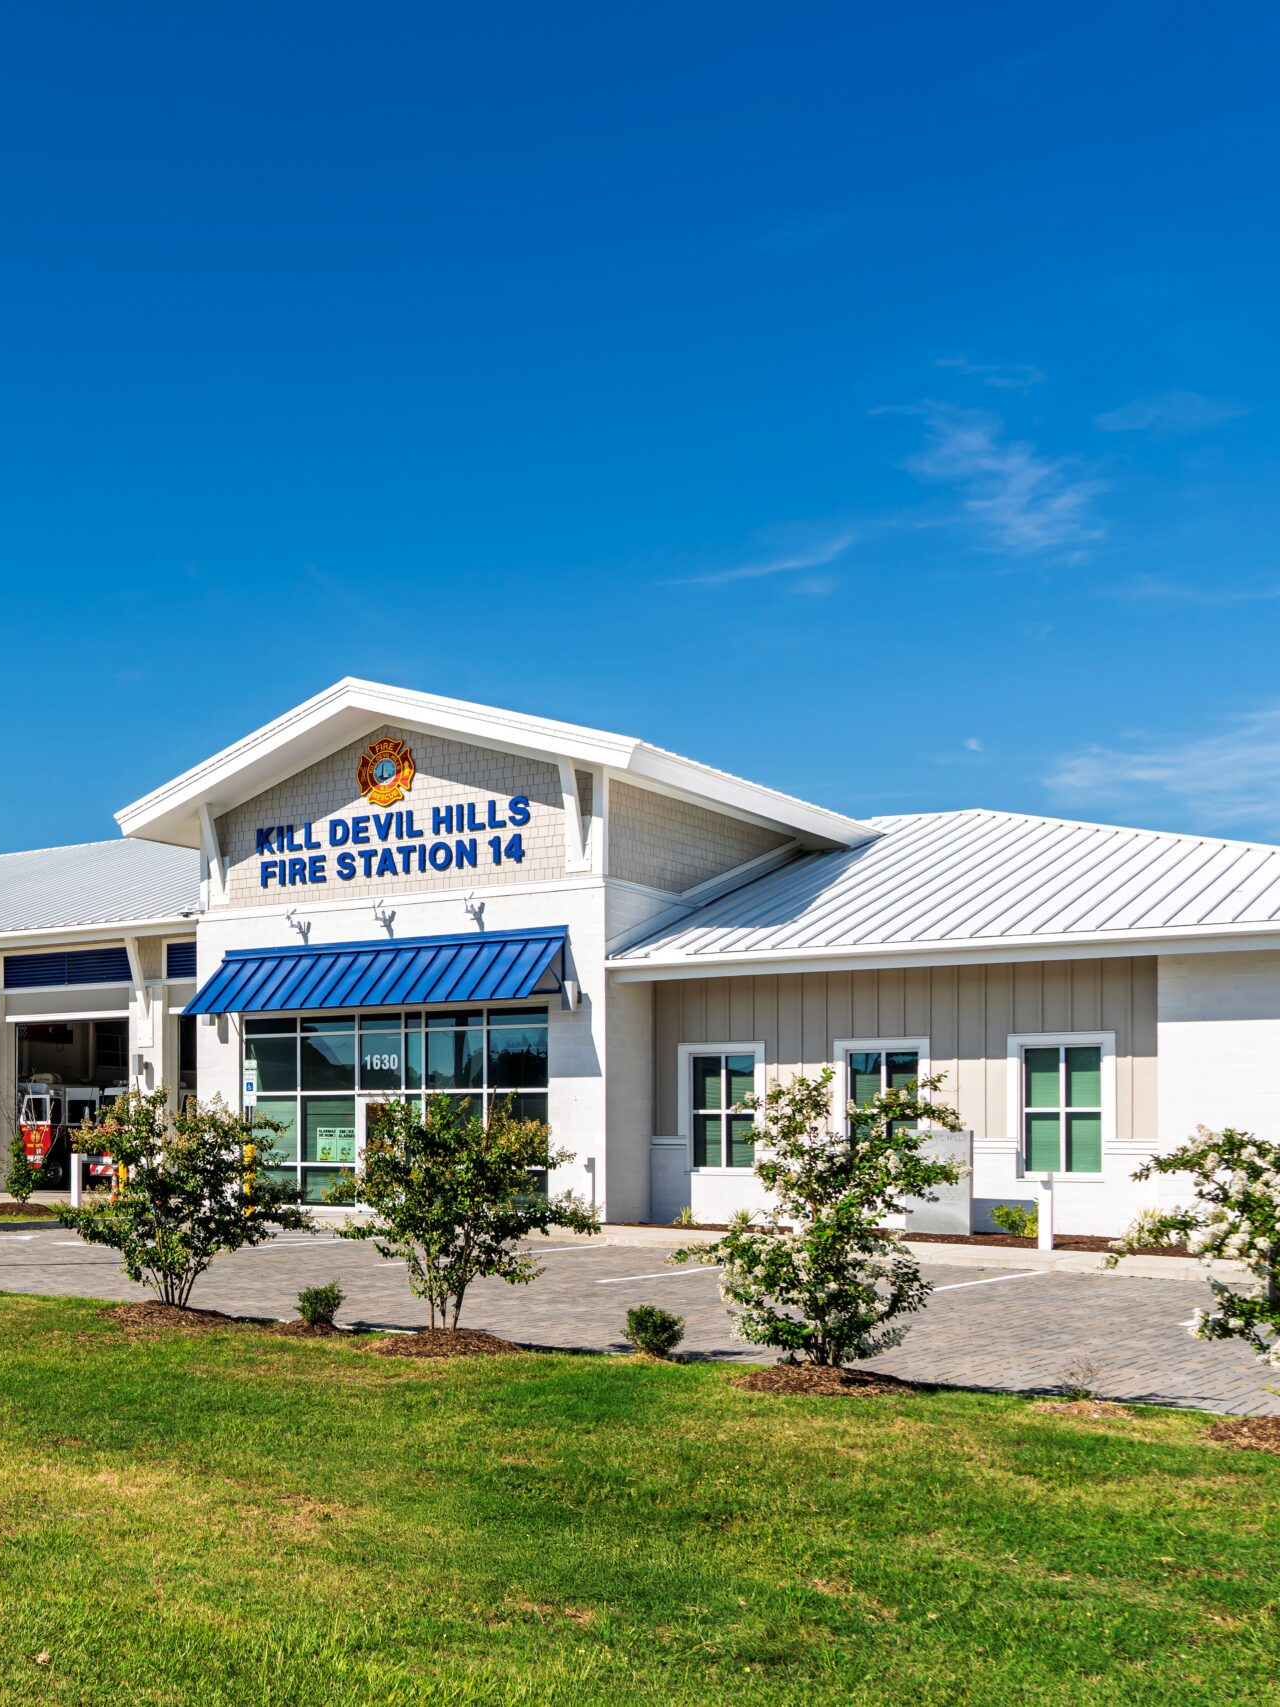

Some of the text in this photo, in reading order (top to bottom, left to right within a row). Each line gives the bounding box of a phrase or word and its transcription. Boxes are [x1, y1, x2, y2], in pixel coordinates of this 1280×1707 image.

[375, 742, 395, 753] FIRE
[373, 791, 399, 800] RESCUE
[256, 796, 531, 856] KILL DEVIL HILLS
[261, 833, 526, 889] FIRE STATION 14
[365, 1053, 399, 1070] 1630
